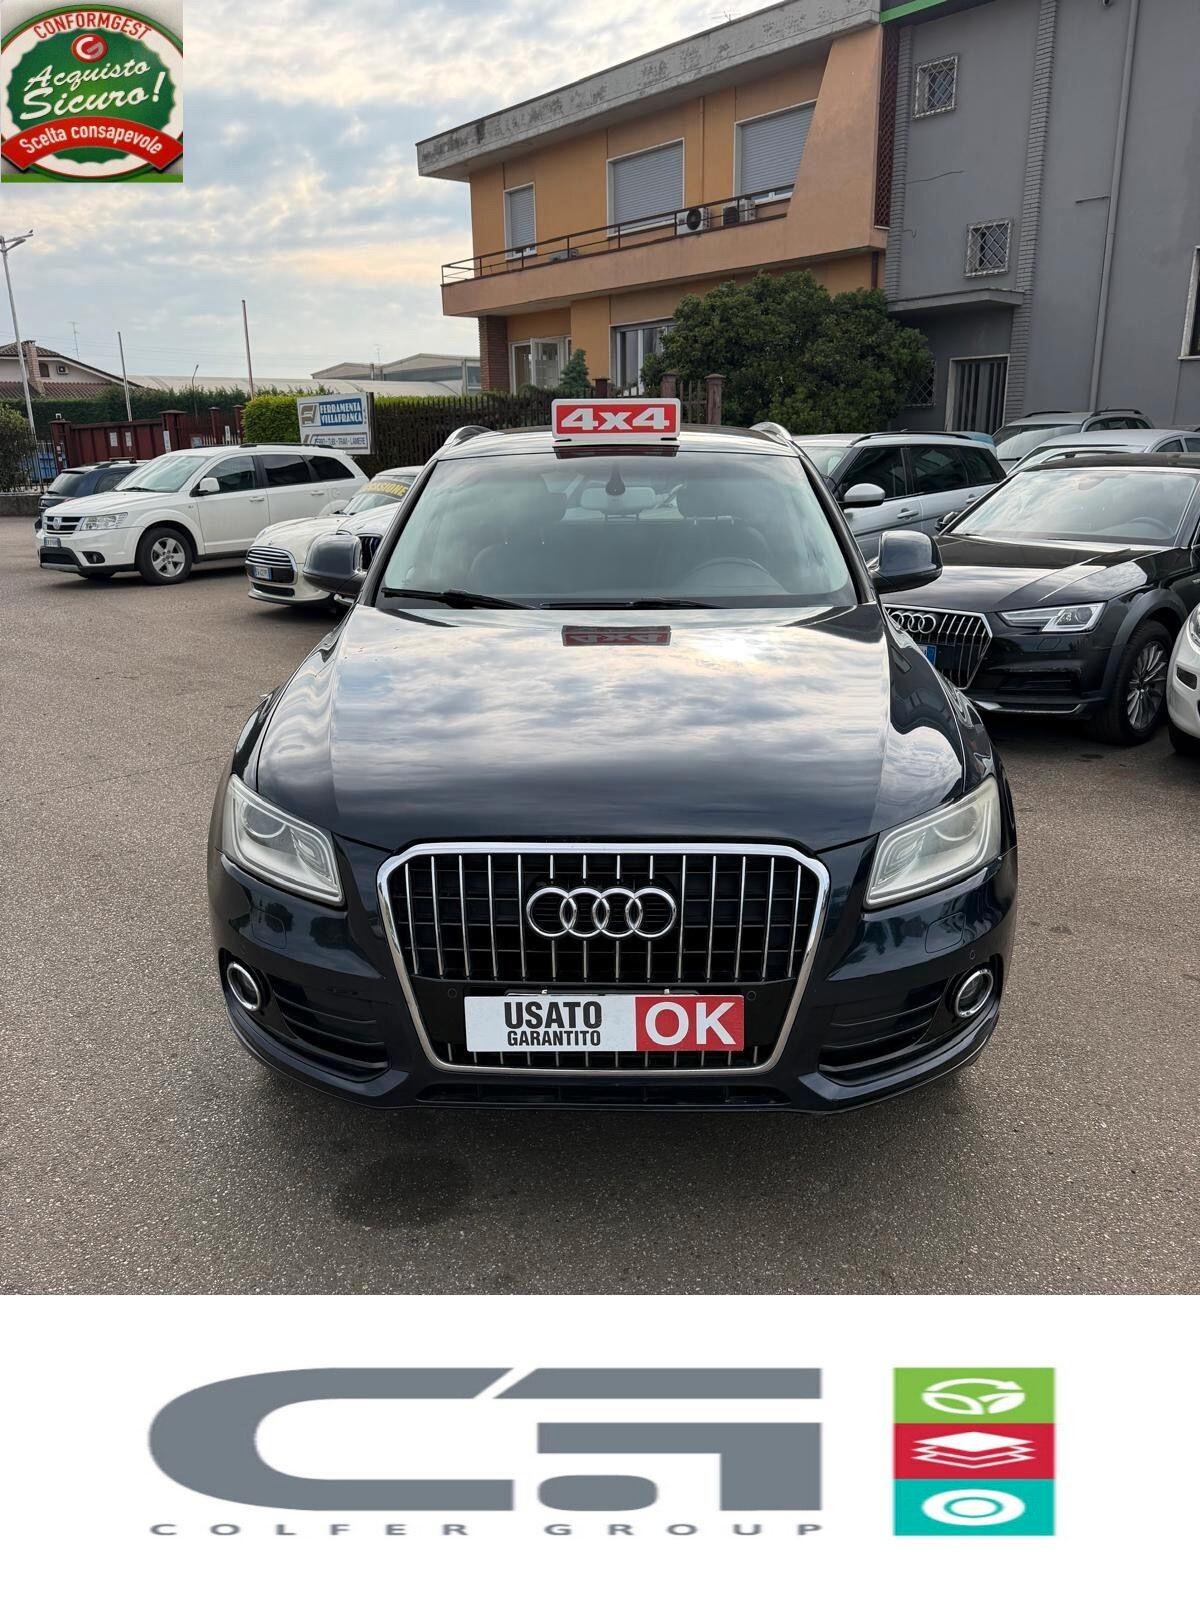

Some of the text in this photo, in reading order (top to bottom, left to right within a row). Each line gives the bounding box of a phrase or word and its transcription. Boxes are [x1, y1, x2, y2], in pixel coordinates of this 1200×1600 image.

[319, 401, 362, 415] FERRAMENTA
[320, 413, 363, 425] VILLAFRANCA
[560, 407, 670, 431] 4x4
[503, 1001, 602, 1029] USATO
[645, 1001, 737, 1046] OK
[507, 1030, 601, 1046] GARANTITO
